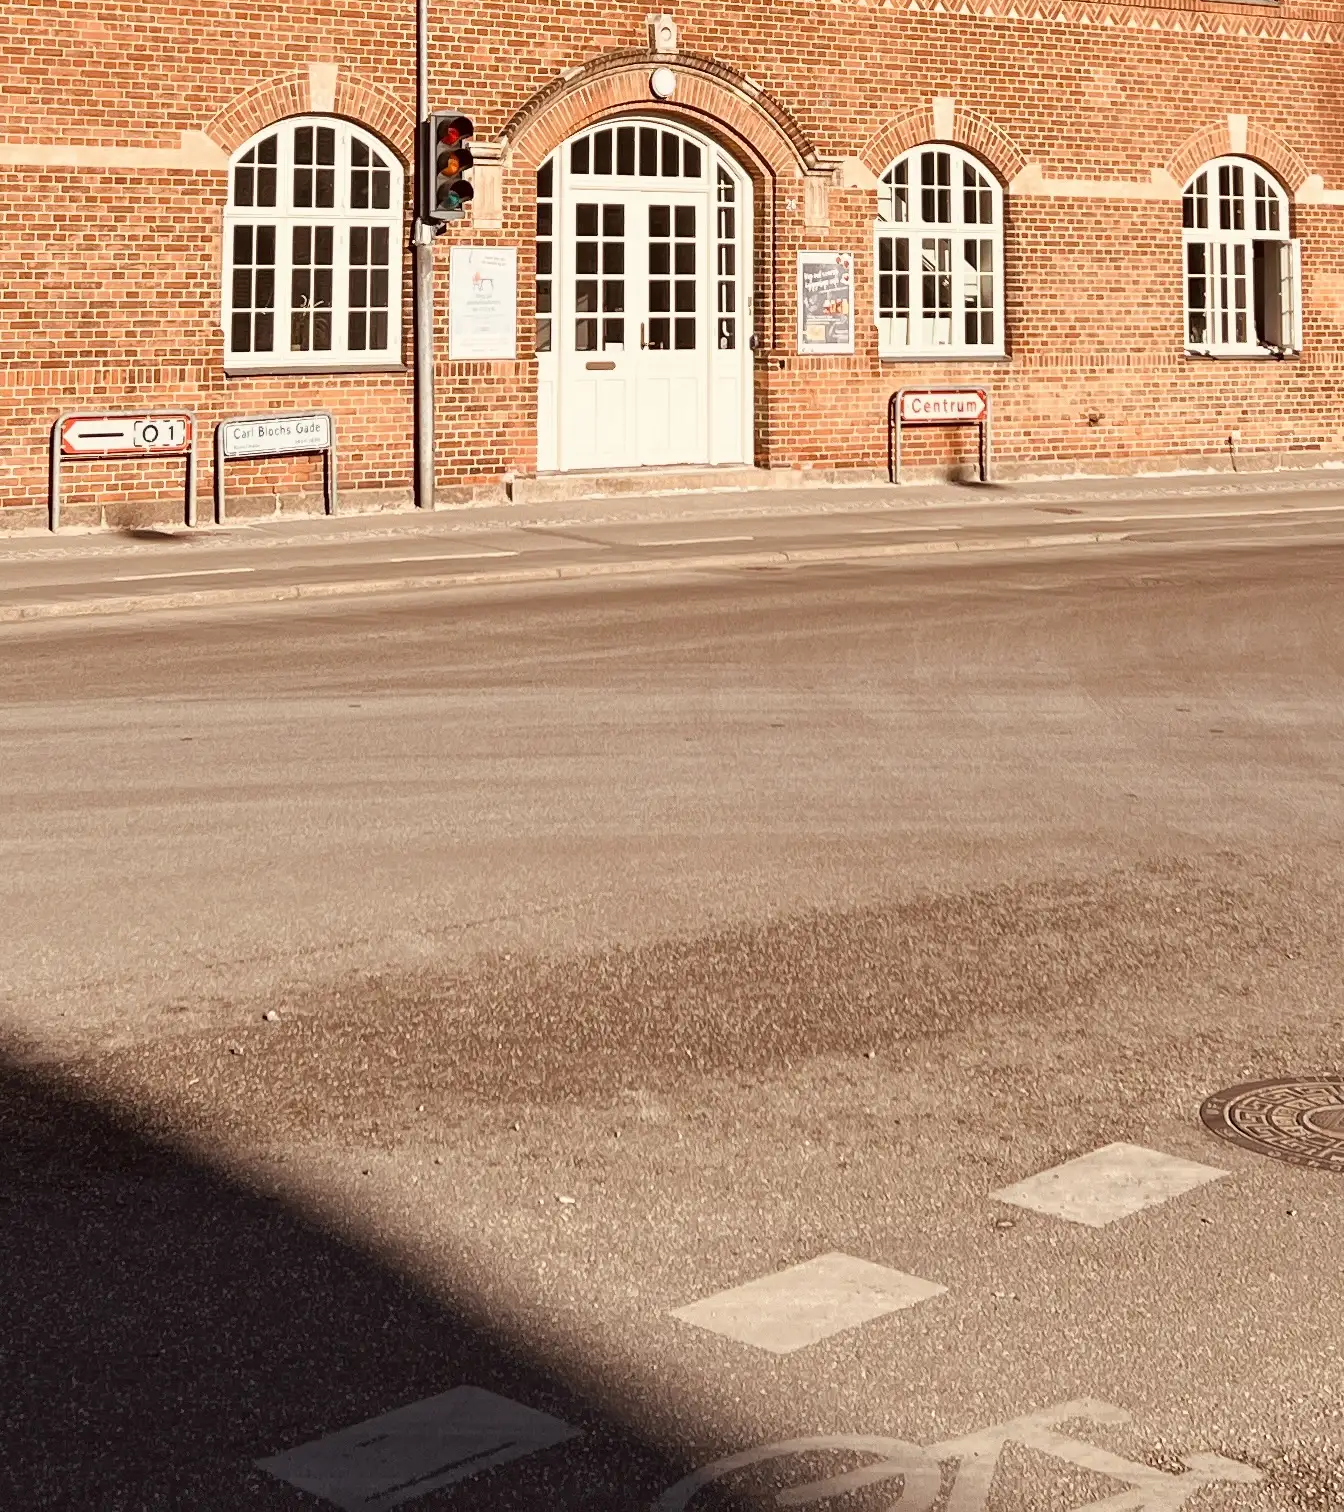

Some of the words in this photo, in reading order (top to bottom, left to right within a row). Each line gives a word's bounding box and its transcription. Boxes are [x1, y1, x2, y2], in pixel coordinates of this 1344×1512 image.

[911, 398, 977, 413] Centrum
[168, 425, 175, 441] 1
[233, 428, 254, 439] Carl
[258, 425, 292, 437] Blochs
[295, 422, 321, 434] Gade
